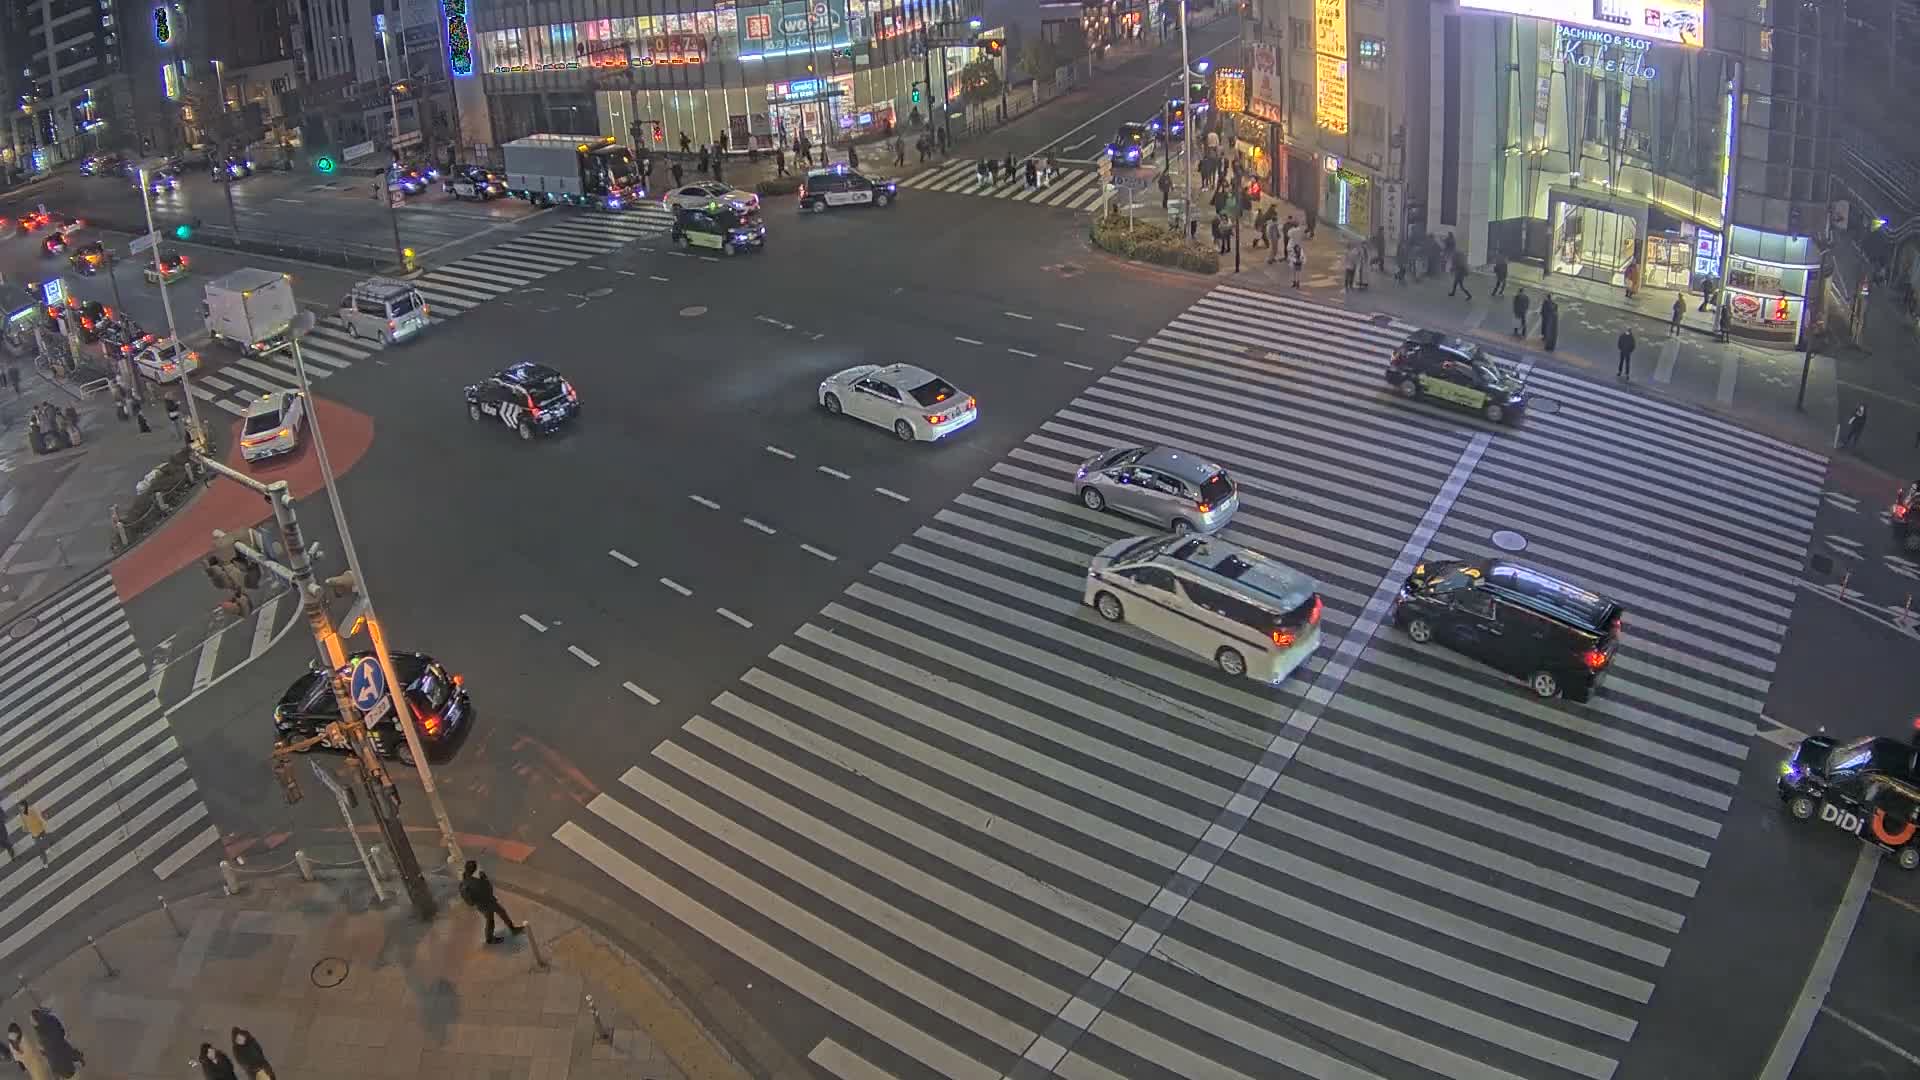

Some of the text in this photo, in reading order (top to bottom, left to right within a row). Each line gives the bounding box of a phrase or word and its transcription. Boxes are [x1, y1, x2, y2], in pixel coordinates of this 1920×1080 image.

[1556, 24, 1652, 51] PACHINKO & SLOT
[1821, 803, 1865, 836] DiDi
